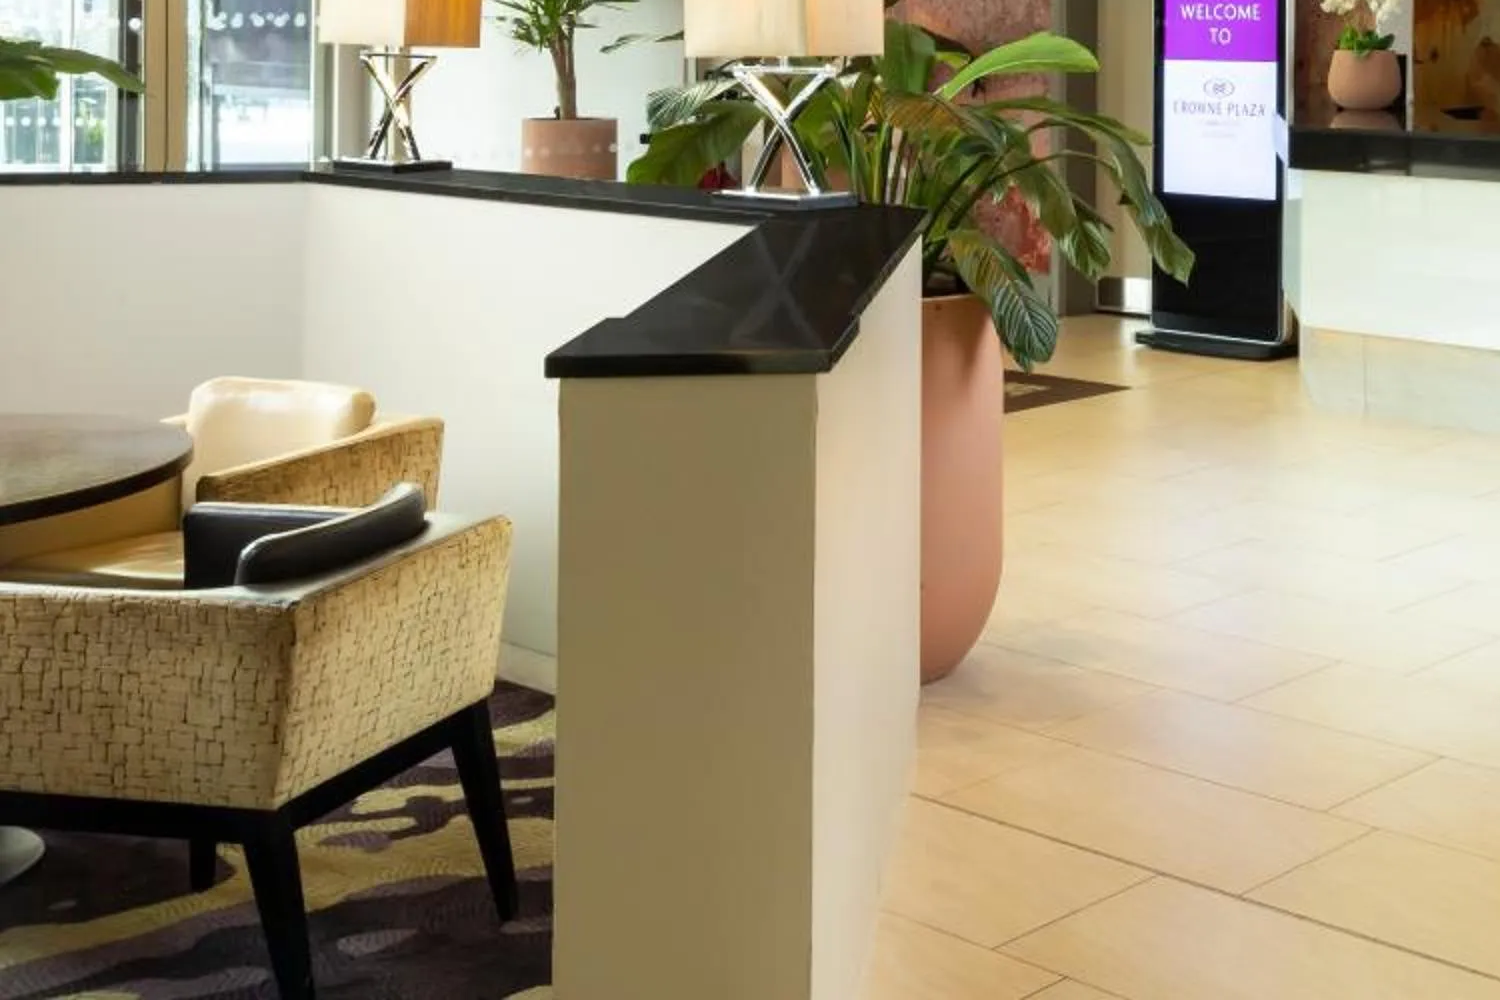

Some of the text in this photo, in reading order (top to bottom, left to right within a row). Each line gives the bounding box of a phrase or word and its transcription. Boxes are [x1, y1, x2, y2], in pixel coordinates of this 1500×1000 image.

[1180, 3, 1262, 21] WELCOME
[1209, 27, 1231, 45] TO
[1227, 101, 1266, 117] PLAZA
